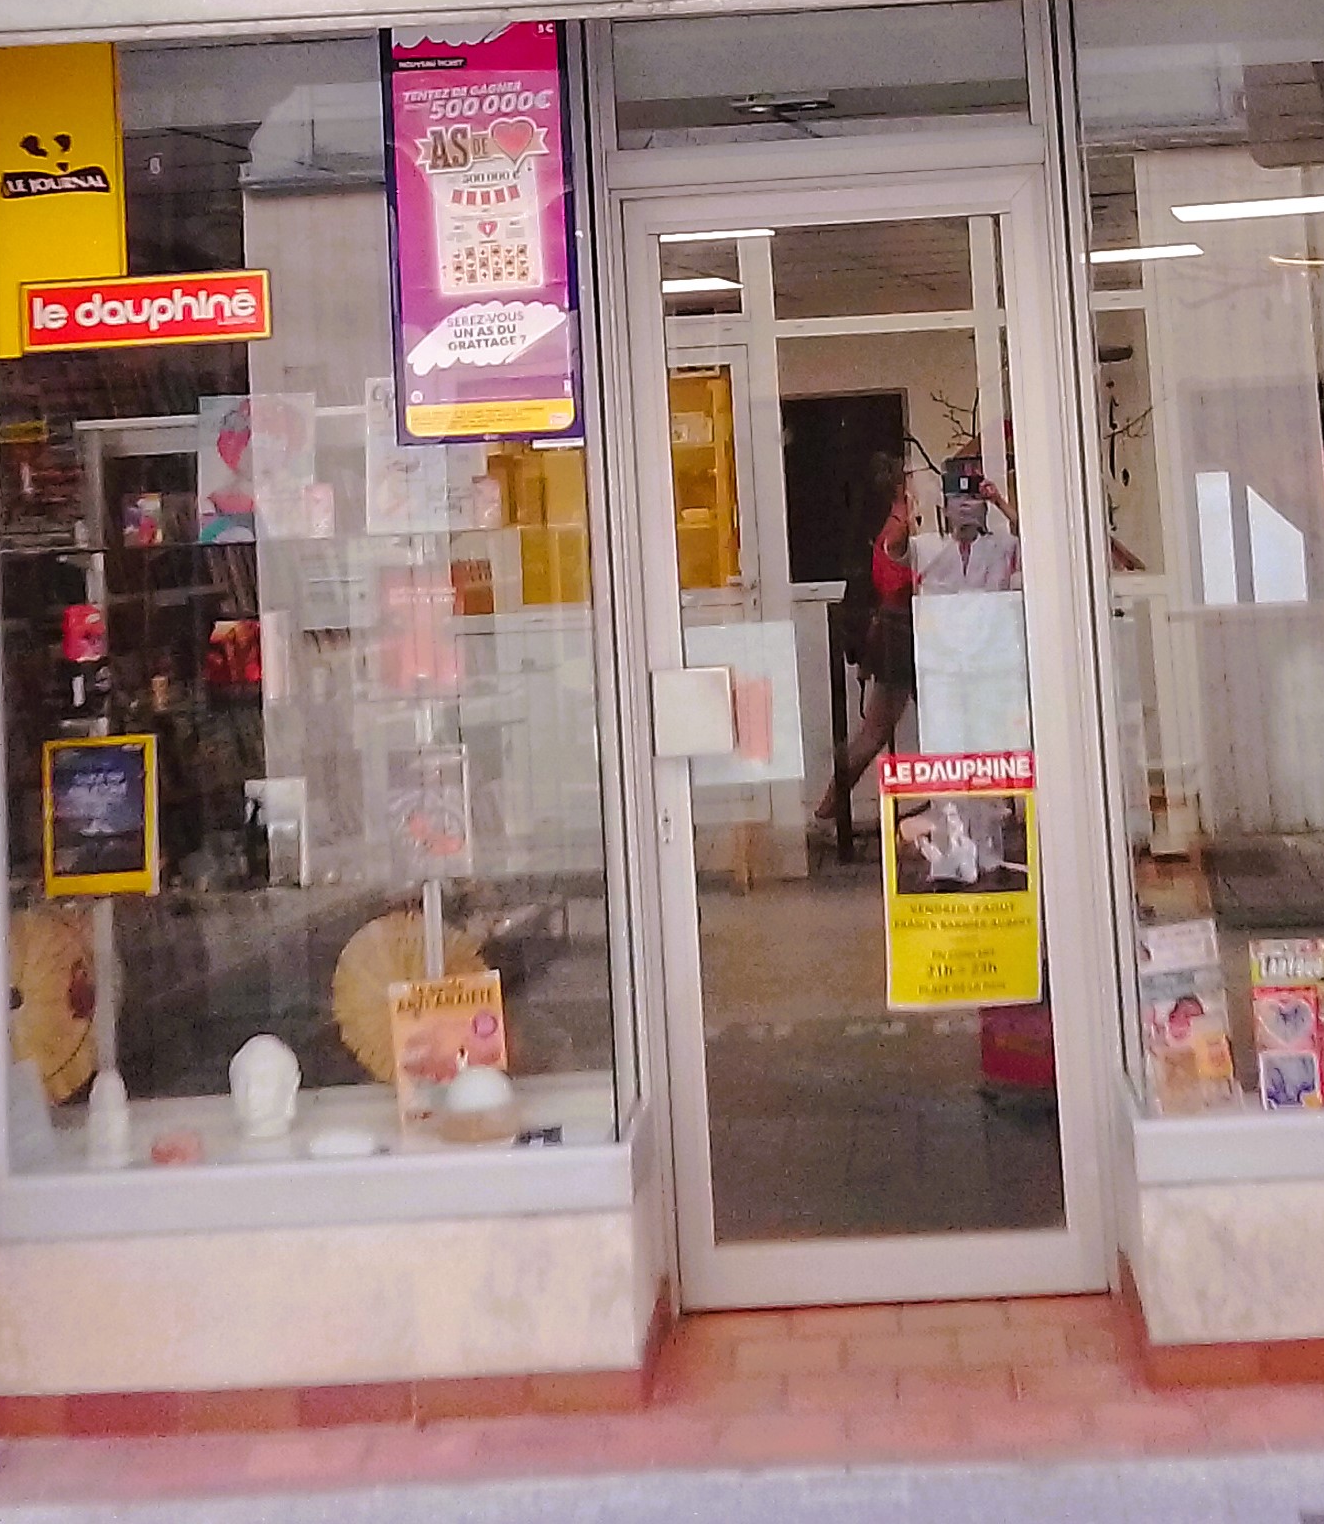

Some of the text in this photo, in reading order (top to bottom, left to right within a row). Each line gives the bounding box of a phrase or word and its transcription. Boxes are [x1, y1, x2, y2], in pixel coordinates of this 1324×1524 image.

[403, 88, 450, 102] TENTEZ
[470, 80, 522, 95] GAGNER
[428, 126, 488, 170] AS DE
[28, 174, 107, 194] JOURNAL
[32, 288, 257, 332] le dauphiné
[453, 324, 516, 338] UN AS DU
[448, 336, 517, 351] GRATTAGE
[883, 762, 912, 785] LE
